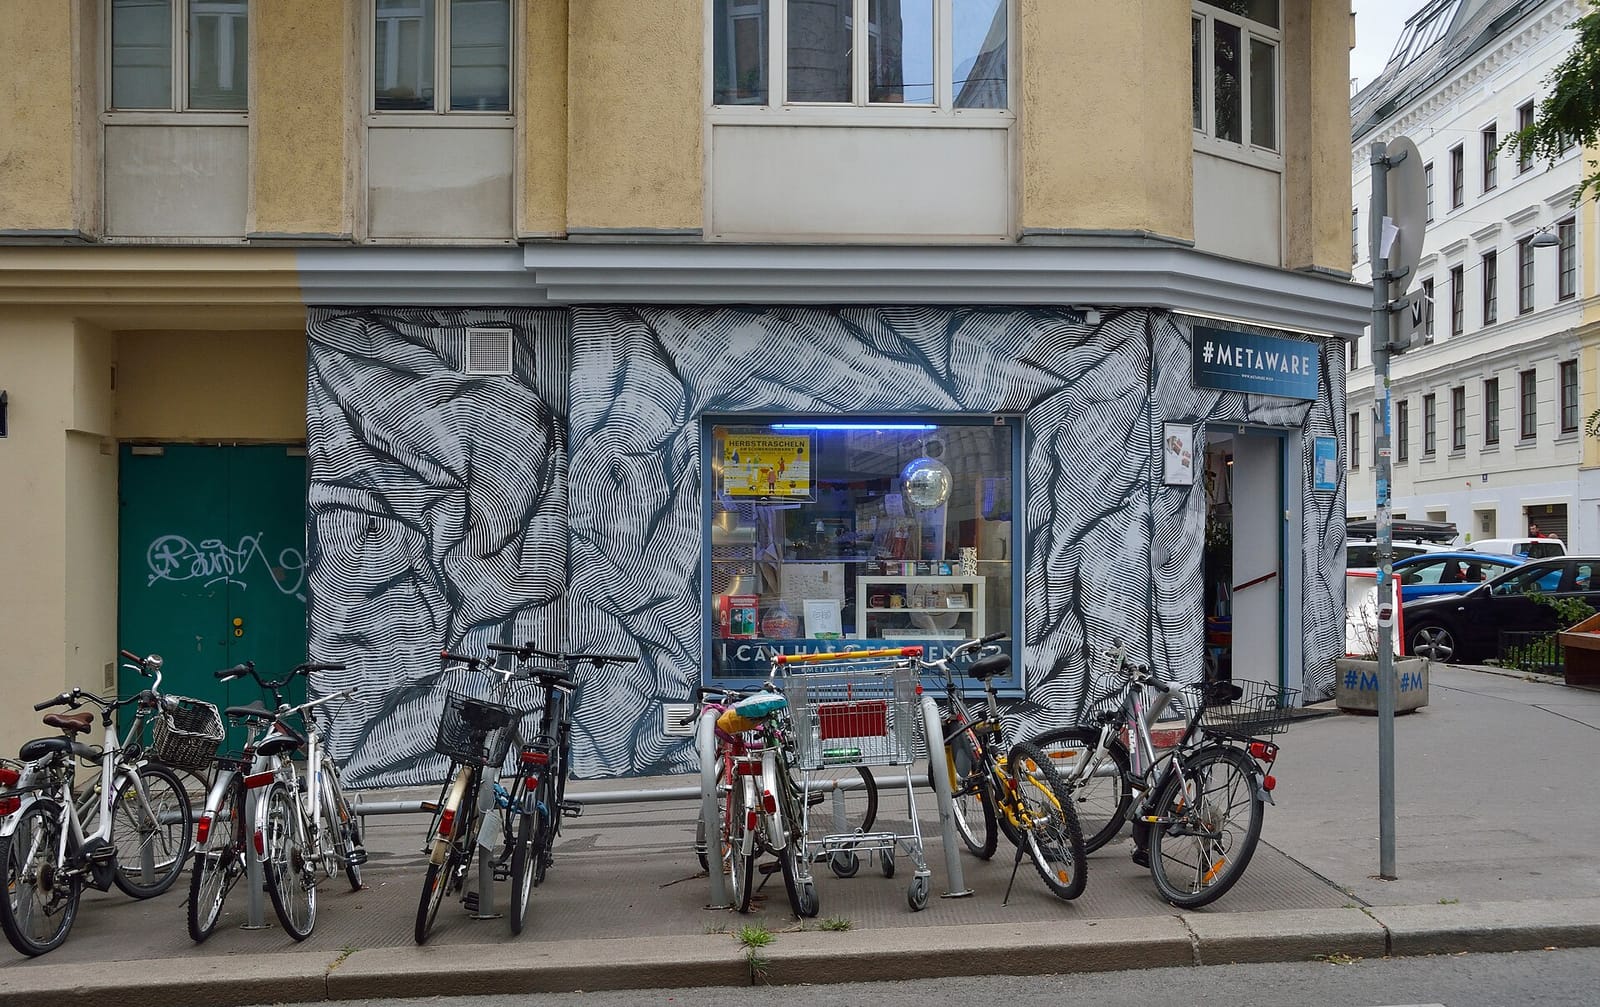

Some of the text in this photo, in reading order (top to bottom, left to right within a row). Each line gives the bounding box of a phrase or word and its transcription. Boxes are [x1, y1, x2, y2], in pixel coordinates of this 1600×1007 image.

[1202, 340, 1310, 376] #METAWARE
[729, 440, 805, 448] HERBSTRASCHELN
[722, 643, 727, 661] I
[737, 643, 785, 662] CAN
